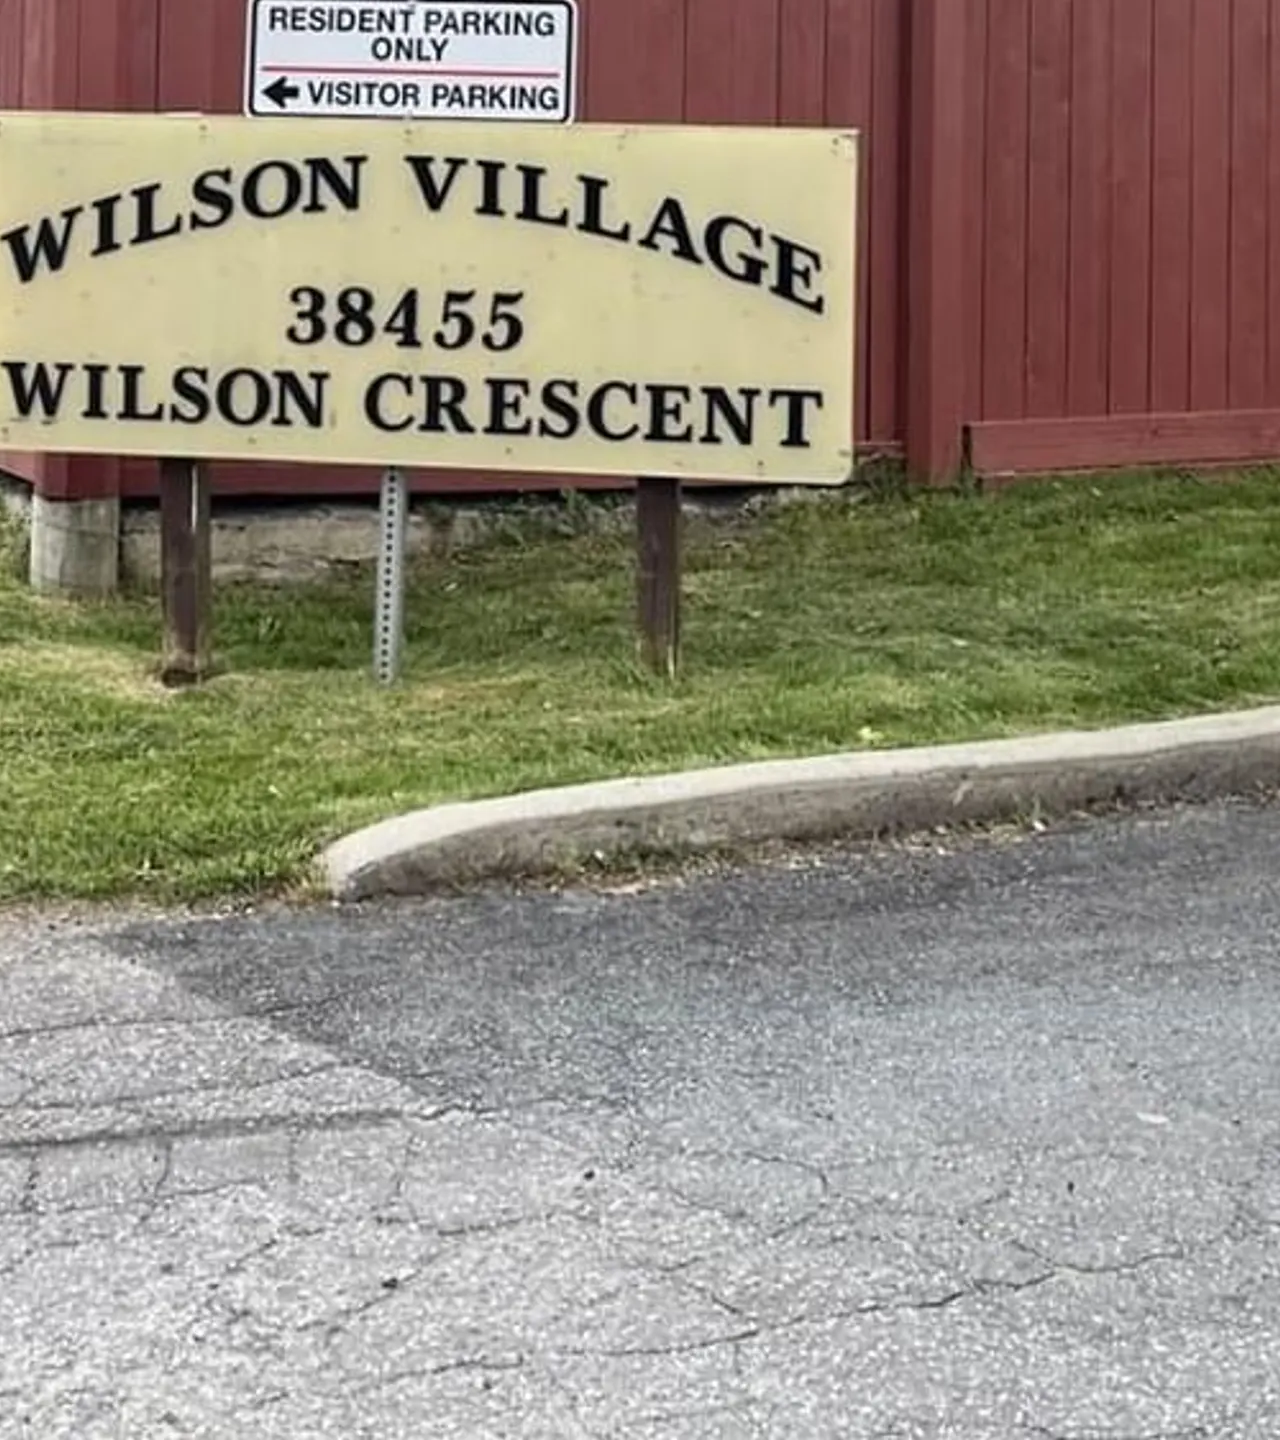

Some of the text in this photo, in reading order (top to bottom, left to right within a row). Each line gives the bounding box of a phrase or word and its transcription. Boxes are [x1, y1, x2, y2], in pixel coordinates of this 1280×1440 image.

[268, 6, 556, 37] RESIDENT PARKING
[370, 36, 449, 63] ONLY
[307, 80, 560, 112] VISITOR PARKING
[0, 154, 824, 315] WILSON VILLAGE
[285, 285, 525, 353] 38455
[0, 360, 824, 448] WILSON CRESCENT
